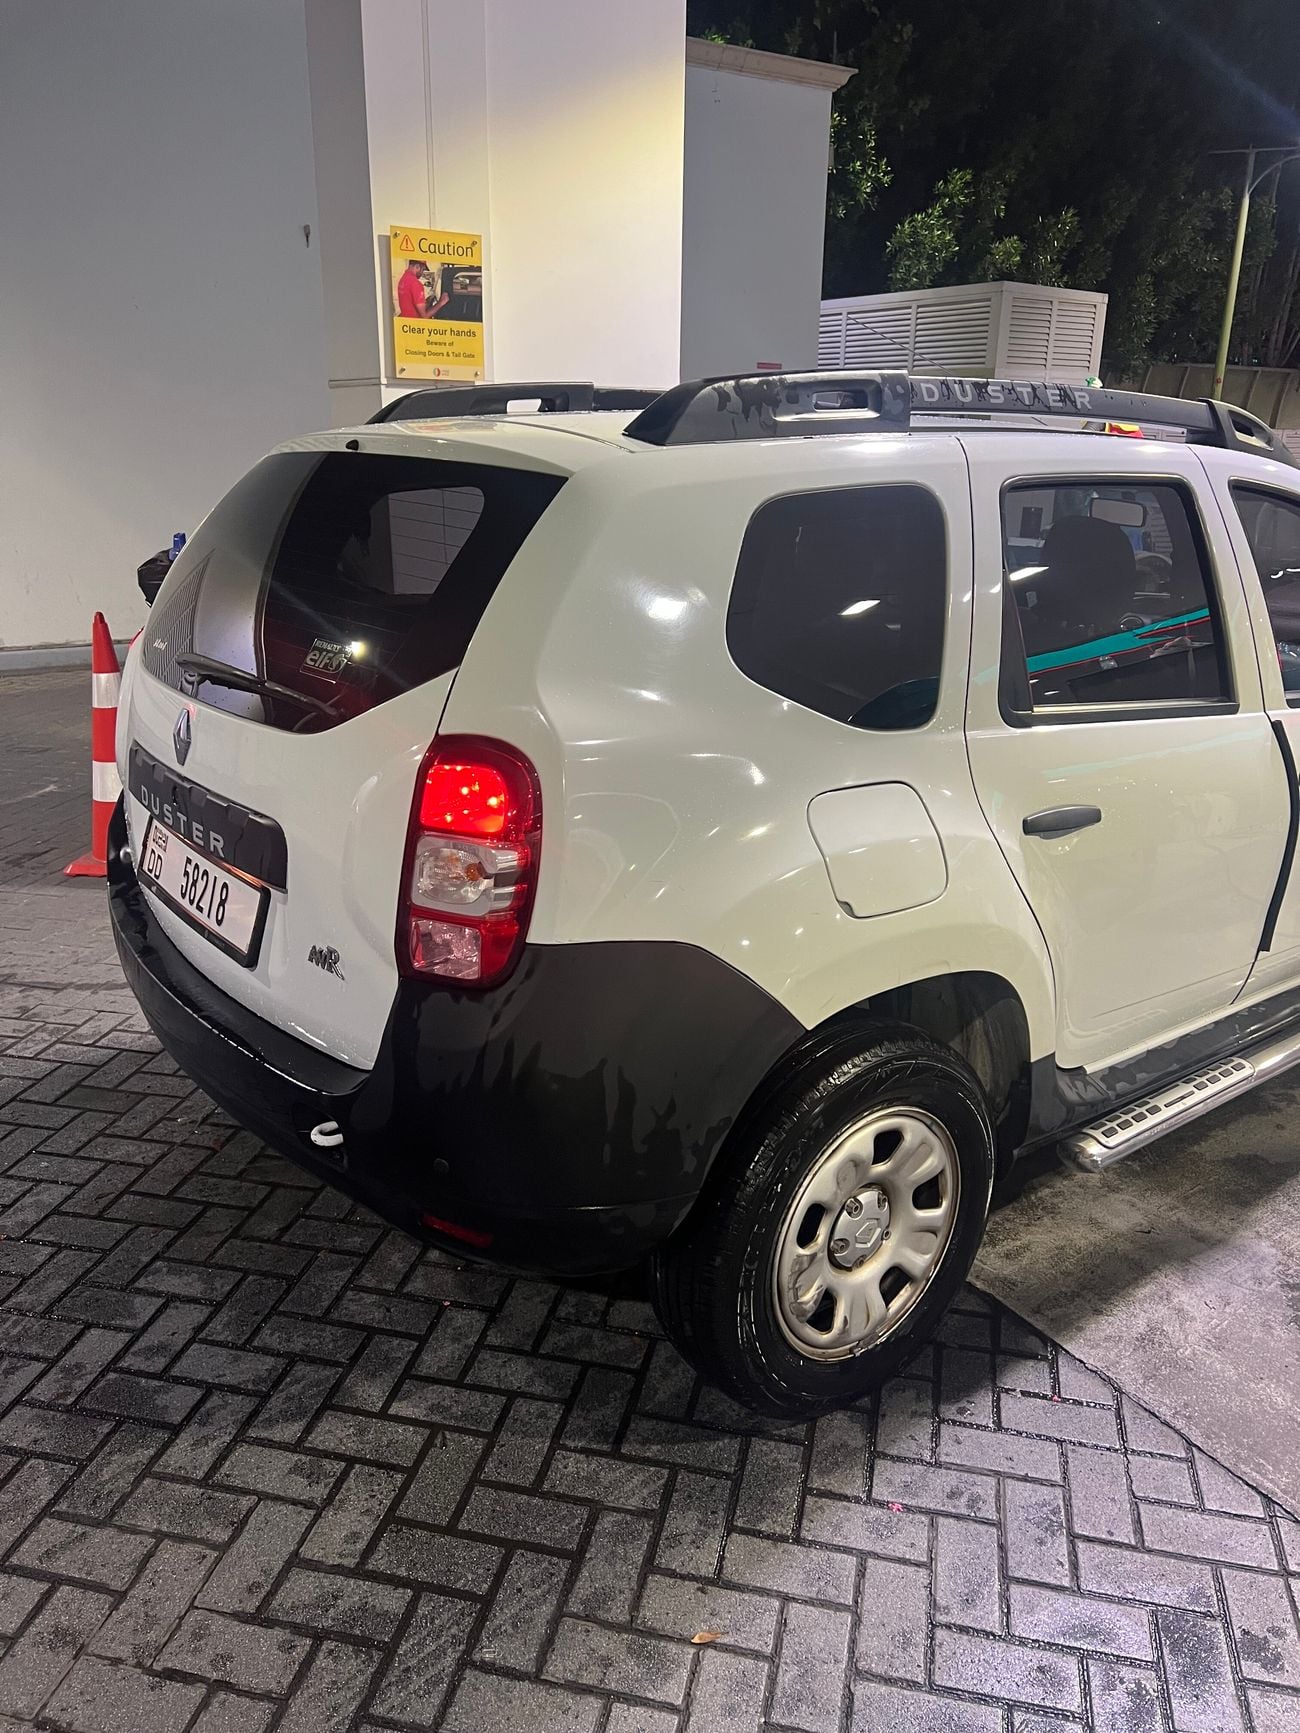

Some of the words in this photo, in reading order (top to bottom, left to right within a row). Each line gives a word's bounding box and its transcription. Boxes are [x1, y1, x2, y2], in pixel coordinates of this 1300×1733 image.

[418, 238, 474, 258] Caution
[402, 325, 425, 334] Clear
[427, 328, 447, 337] your
[450, 328, 477, 338] hands
[405, 349, 427, 357] Closing
[920, 382, 1093, 410] DUSTER
[141, 785, 225, 858] DUSTER
[147, 848, 164, 881] DD
[180, 855, 230, 927] 58218
